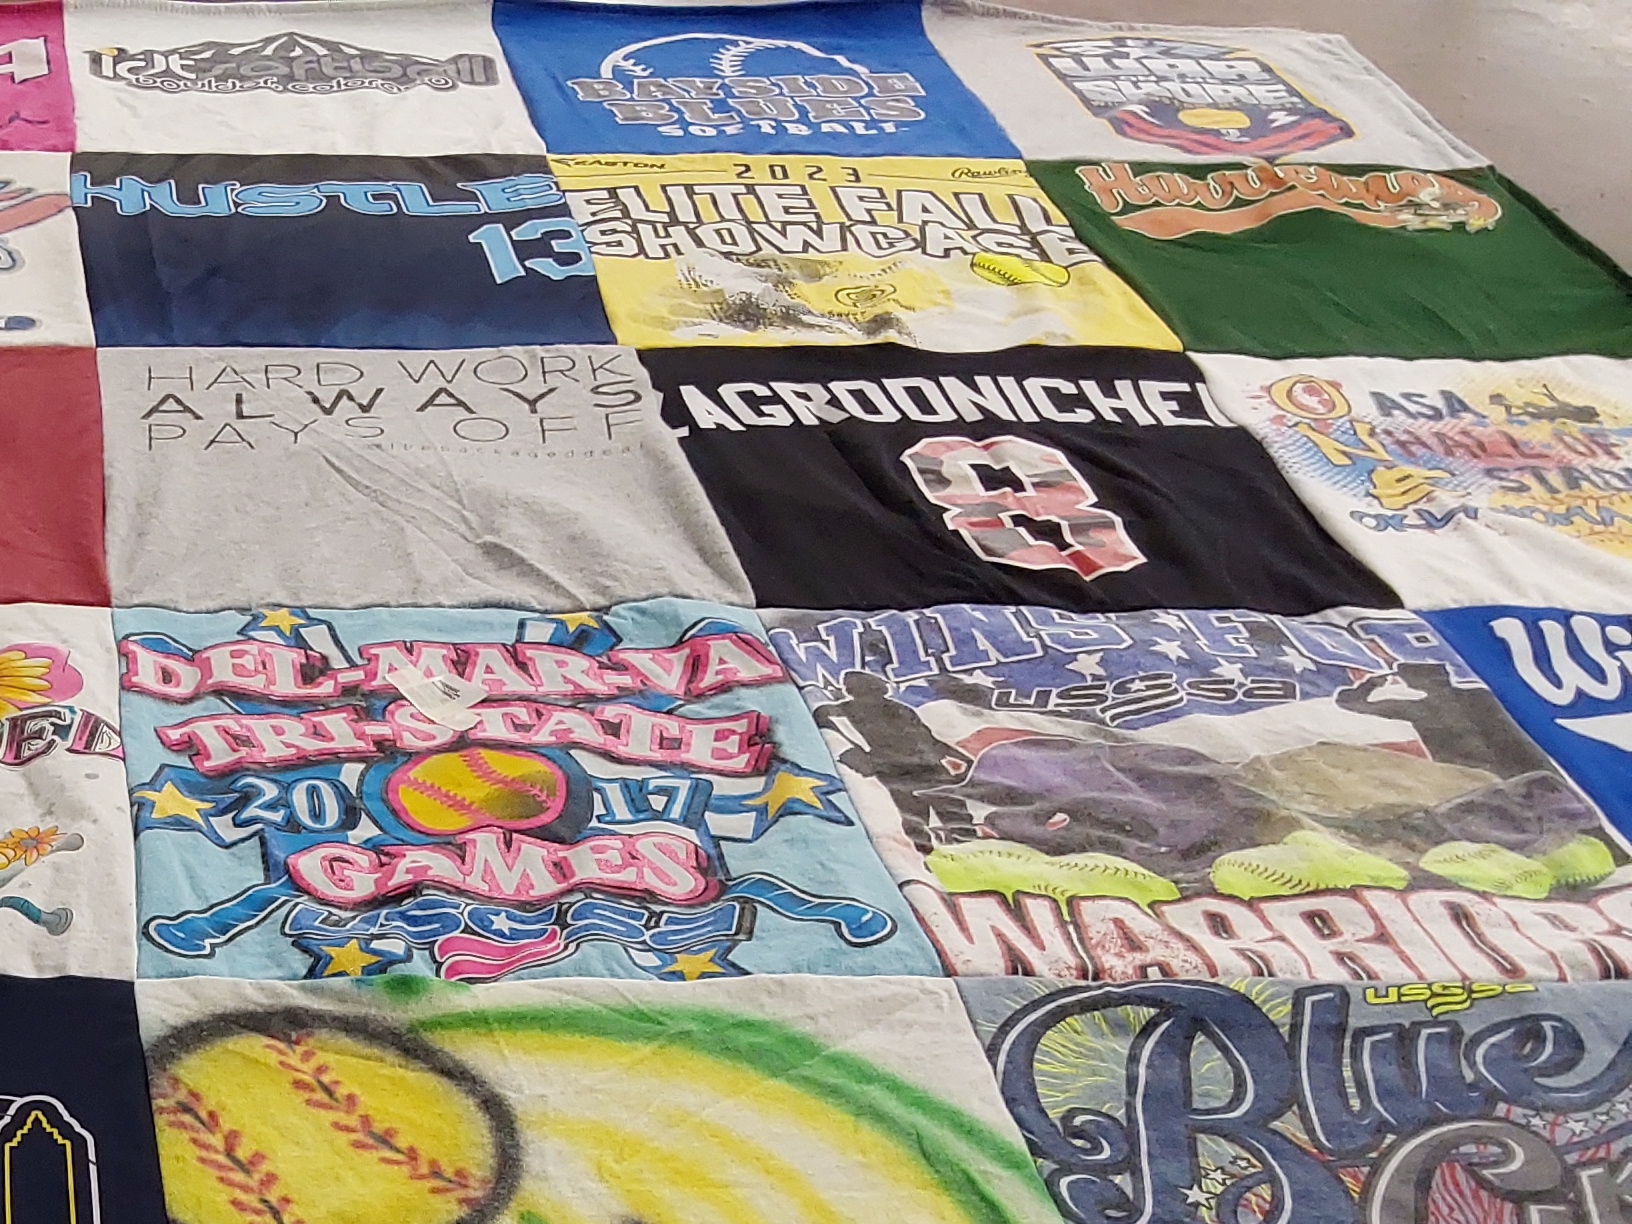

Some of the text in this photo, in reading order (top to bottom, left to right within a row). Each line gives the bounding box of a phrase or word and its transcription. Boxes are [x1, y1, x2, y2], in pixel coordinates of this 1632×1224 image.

[567, 72, 927, 101] BAYSIDE
[602, 97, 926, 126] BLUES
[570, 159, 667, 170] EASTON
[731, 163, 864, 183] 2023
[71, 171, 566, 218] HUSTLE
[565, 182, 1077, 238] ELITE FALL
[469, 217, 596, 285] 13
[580, 219, 1105, 266] SHOWCASE
[146, 354, 636, 392] HARD WORK
[140, 378, 645, 422] ALWAYS
[1369, 388, 1489, 422] ASA
[146, 414, 387, 452] PAYS
[451, 409, 644, 445] OFF
[899, 434, 1149, 583] 8
[120, 634, 786, 702] DEL-MAR-VA
[769, 603, 1136, 686] WINS
[159, 704, 771, 776] TRI-STATE
[286, 827, 719, 903] GAMES
